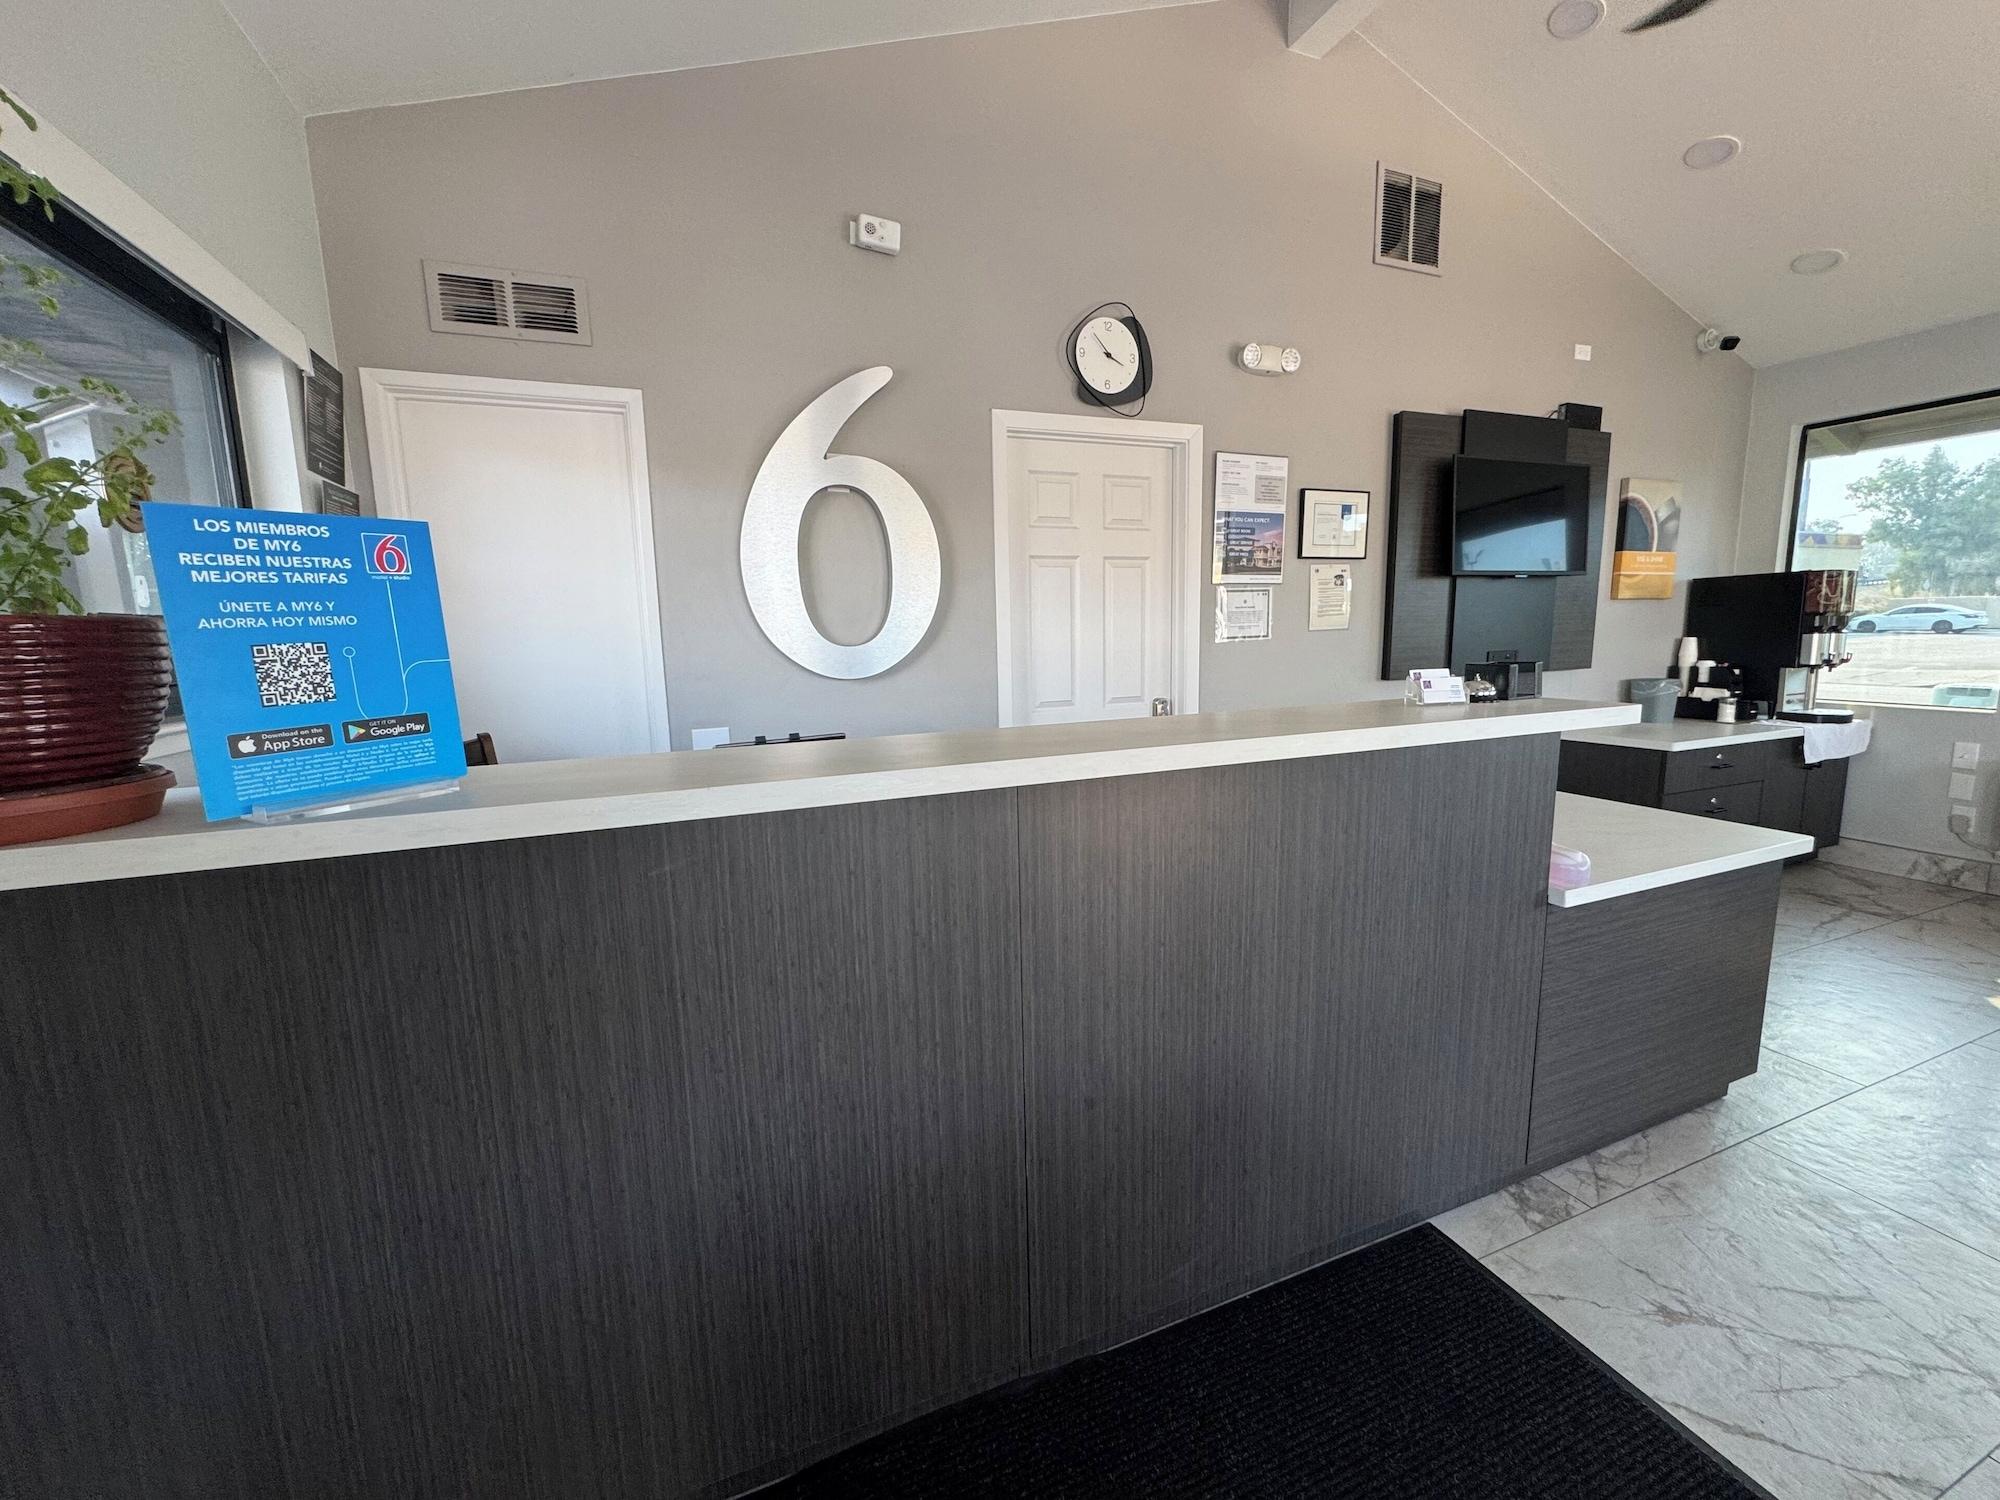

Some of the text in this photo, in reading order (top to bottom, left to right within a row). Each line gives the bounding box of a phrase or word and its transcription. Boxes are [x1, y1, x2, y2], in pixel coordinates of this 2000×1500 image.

[1104, 321, 1112, 331] 12
[1079, 347, 1085, 357] 9
[1130, 354, 1136, 363] 3
[1104, 379, 1111, 389] 6
[193, 518, 330, 538] LOS MIEMBROS
[740, 366, 942, 680] 6
[233, 538, 302, 552] DE MY6
[178, 552, 352, 569] RECIBEN NUESTRAS
[374, 535, 407, 574] 6
[191, 570, 348, 584] MEJORES TARIFAS
[219, 599, 334, 613] ÚNETE A MY6 Y
[198, 615, 358, 629] AHORRA HOY MISMO
[262, 730, 299, 739] Download
[370, 722, 425, 737] Google Play
[263, 735, 325, 753] App Store
